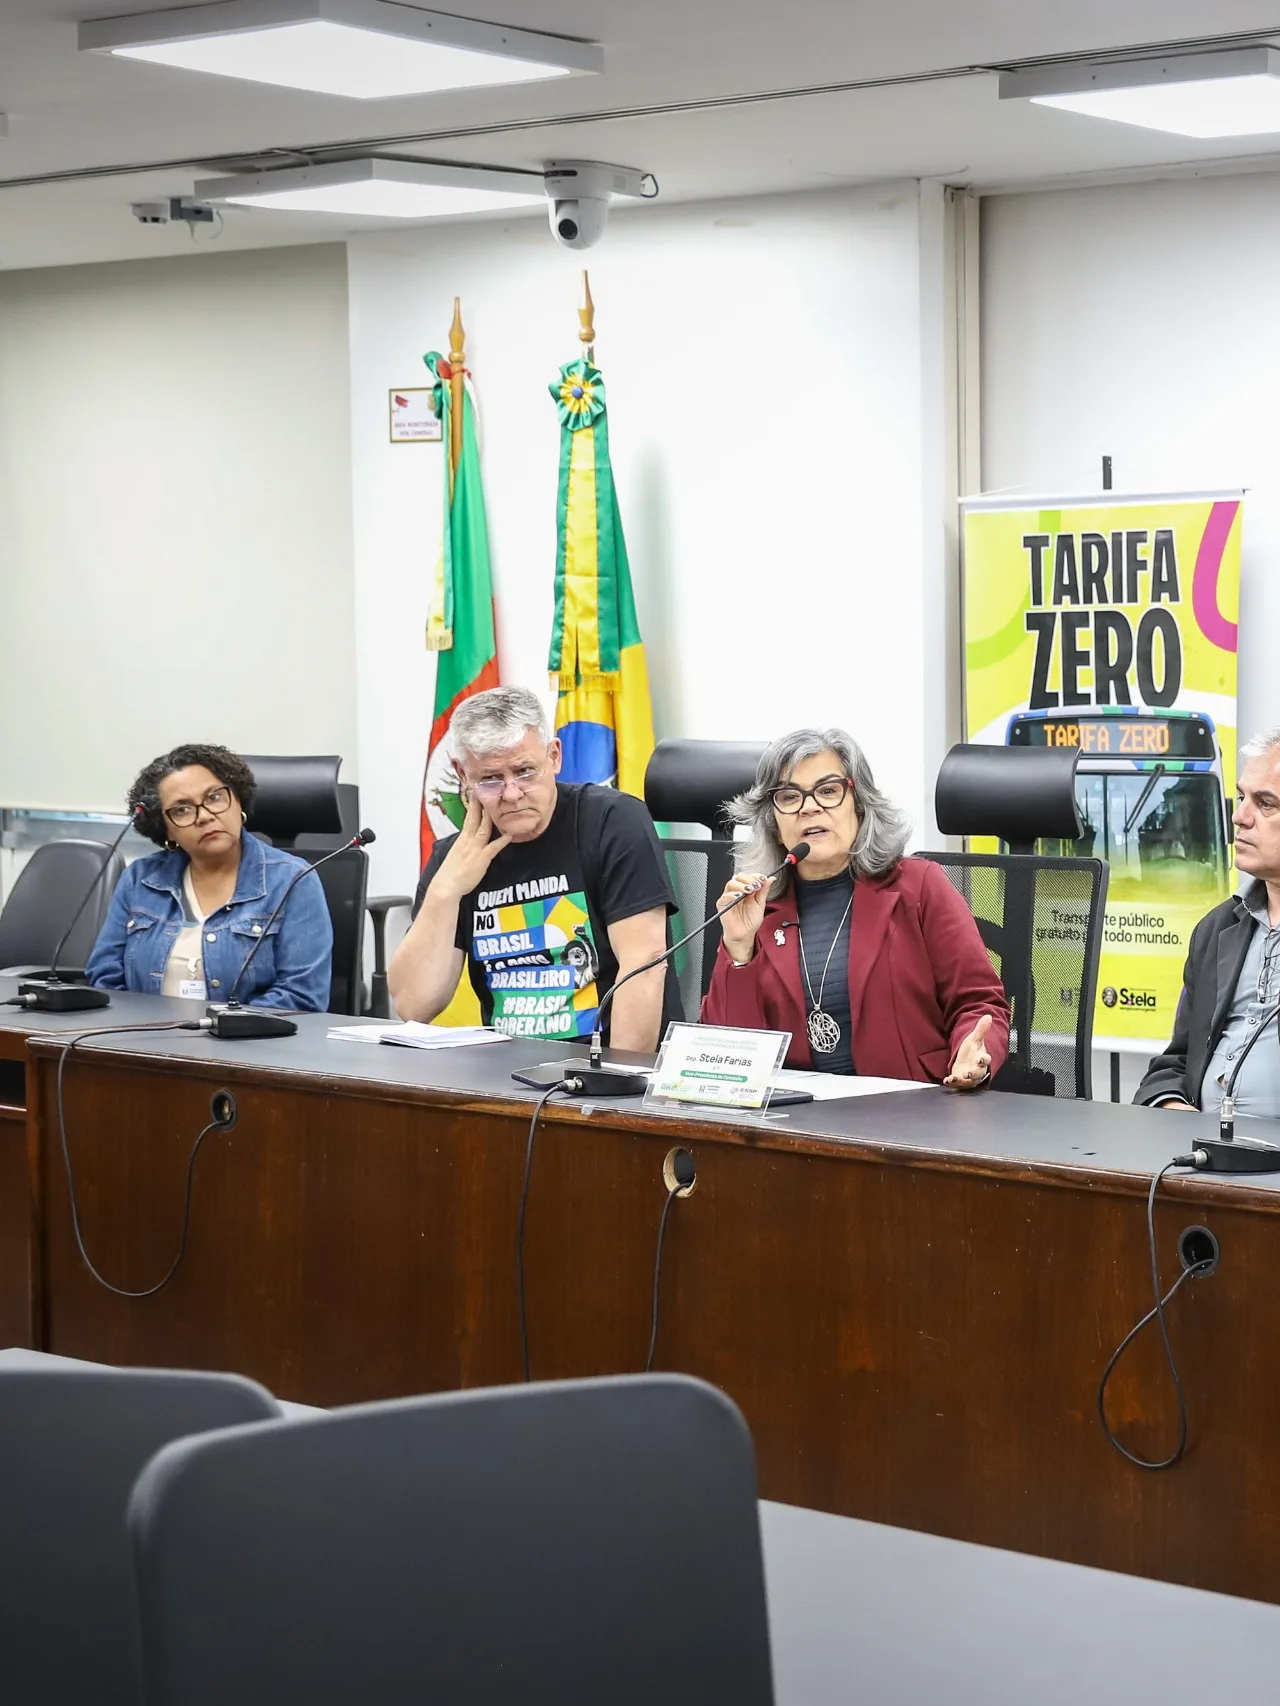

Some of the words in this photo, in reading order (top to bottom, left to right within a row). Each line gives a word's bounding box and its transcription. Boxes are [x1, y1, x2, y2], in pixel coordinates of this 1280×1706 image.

[1022, 529, 1180, 606] TARIFA
[1025, 607, 1182, 709] ZERO
[1043, 724, 1110, 752] TARIFA
[1119, 724, 1170, 753] ZERO
[478, 885, 514, 910] QUEM
[516, 874, 569, 901] MANDA
[476, 913, 495, 931] NO
[1119, 913, 1164, 928] público
[476, 932, 534, 957] BRASIL
[1104, 930, 1132, 942] todo
[1135, 932, 1183, 945] mundo.
[490, 969, 571, 989] BRASILEIRO
[503, 995, 570, 1015] #BRASIL
[1119, 988, 1156, 1007] Stela
[494, 1012, 572, 1035] SOBERANO
[699, 1053, 723, 1064] Stela
[724, 1055, 753, 1067] Farias
